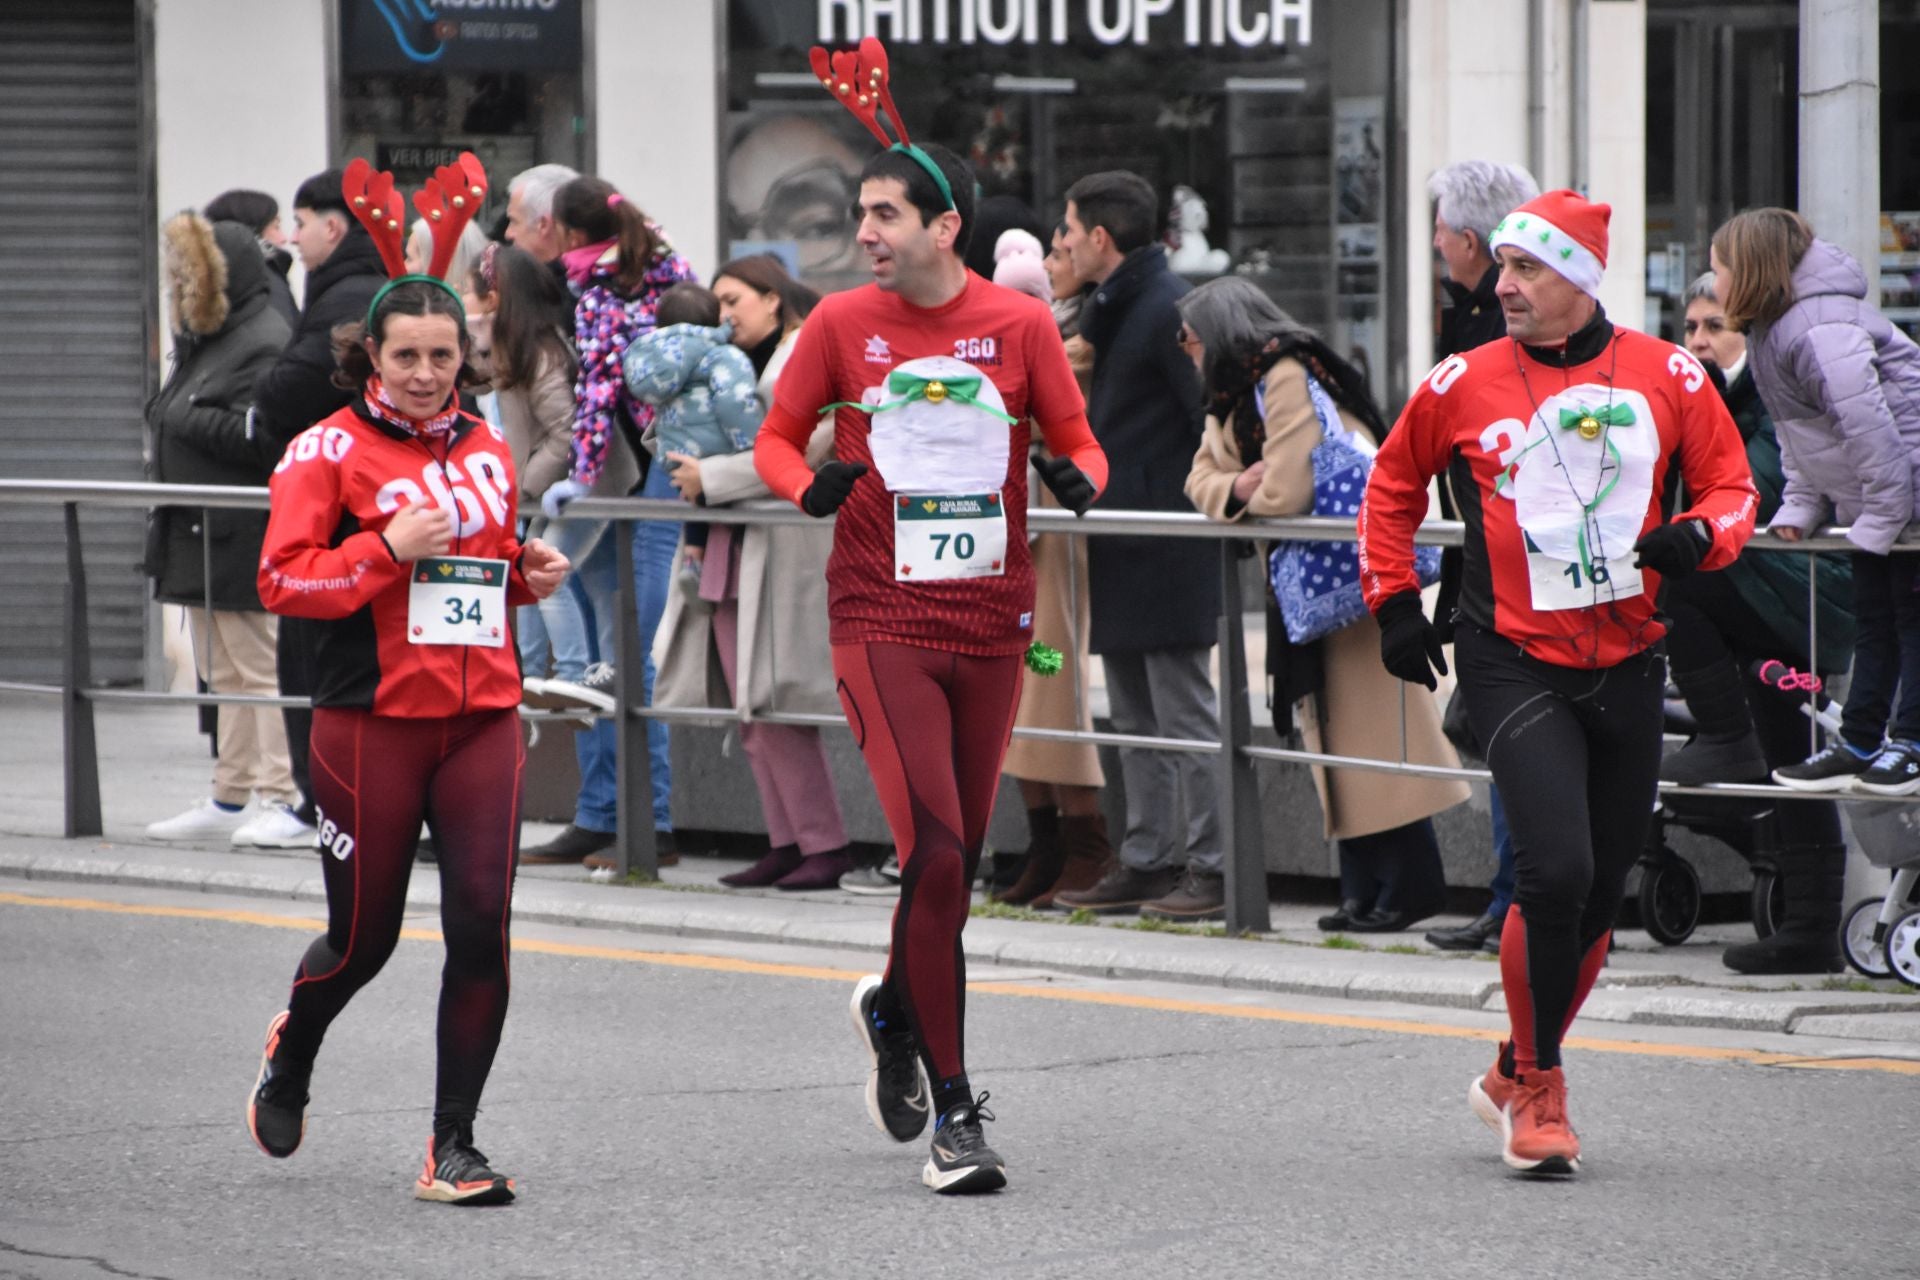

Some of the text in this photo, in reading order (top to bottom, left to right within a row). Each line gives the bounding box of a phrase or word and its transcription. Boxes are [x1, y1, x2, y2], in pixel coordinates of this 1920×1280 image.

[389, 147, 421, 167] VER
[953, 337, 995, 359] 360
[929, 532, 975, 561] 70
[444, 597, 483, 626] 34
